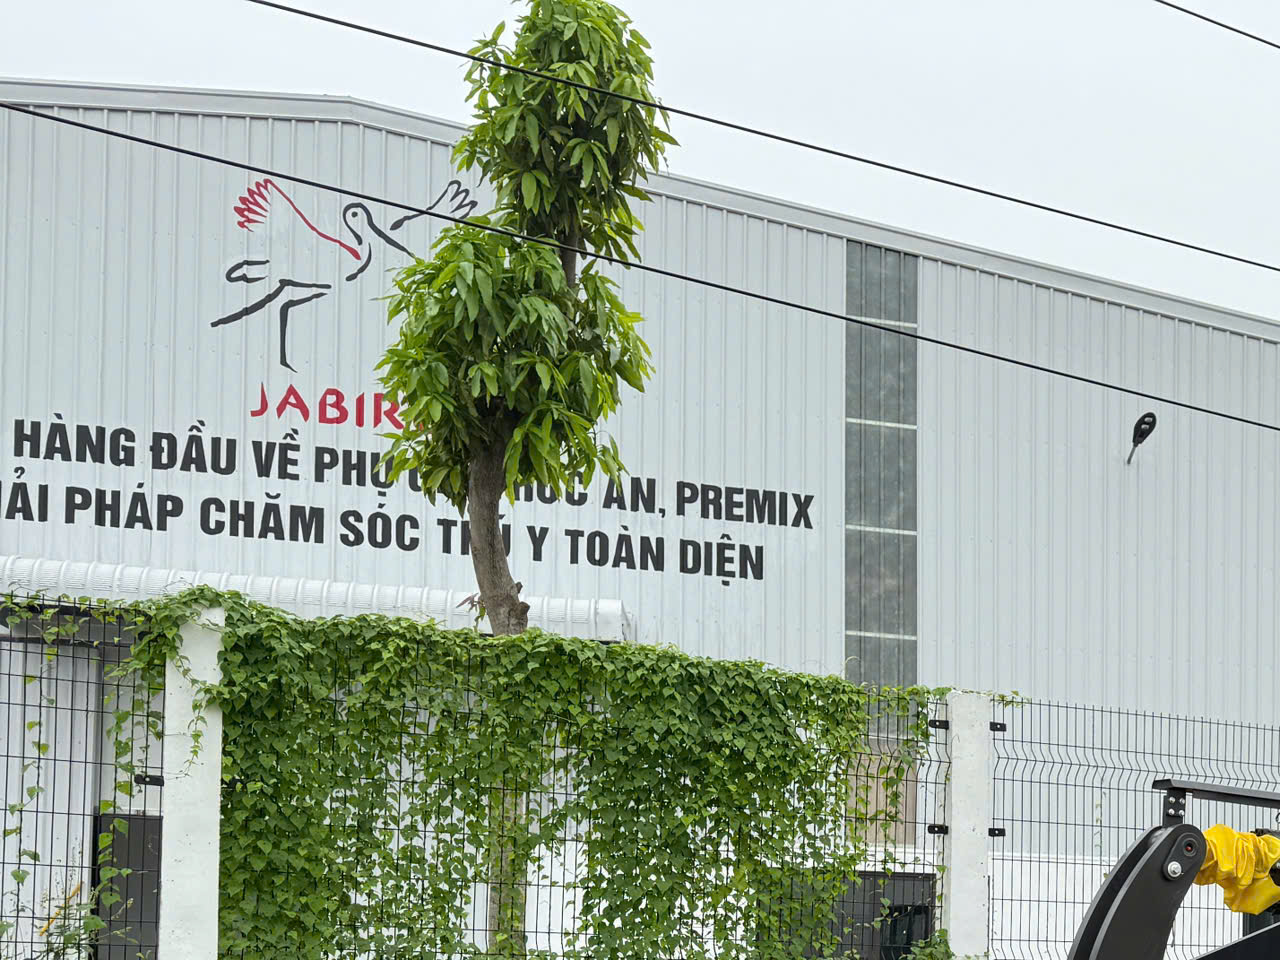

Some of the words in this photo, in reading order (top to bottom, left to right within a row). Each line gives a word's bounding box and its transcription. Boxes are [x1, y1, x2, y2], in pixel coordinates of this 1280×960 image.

[250, 383, 424, 433] JABIR
[0, 466, 49, 523] ẢI
[65, 482, 184, 532] PHÁP
[200, 492, 325, 545] CHĂM
[340, 502, 420, 551] SÓC
[526, 525, 549, 562] Y
[565, 525, 665, 573] TOÀN
[679, 533, 764, 586] DIỆN
[14, 412, 136, 467] HÀNG
[150, 420, 236, 476] ĐẦU
[252, 428, 301, 480] VỀ
[314, 446, 395, 497] PHỤ
[676, 481, 815, 529] PREMIX
